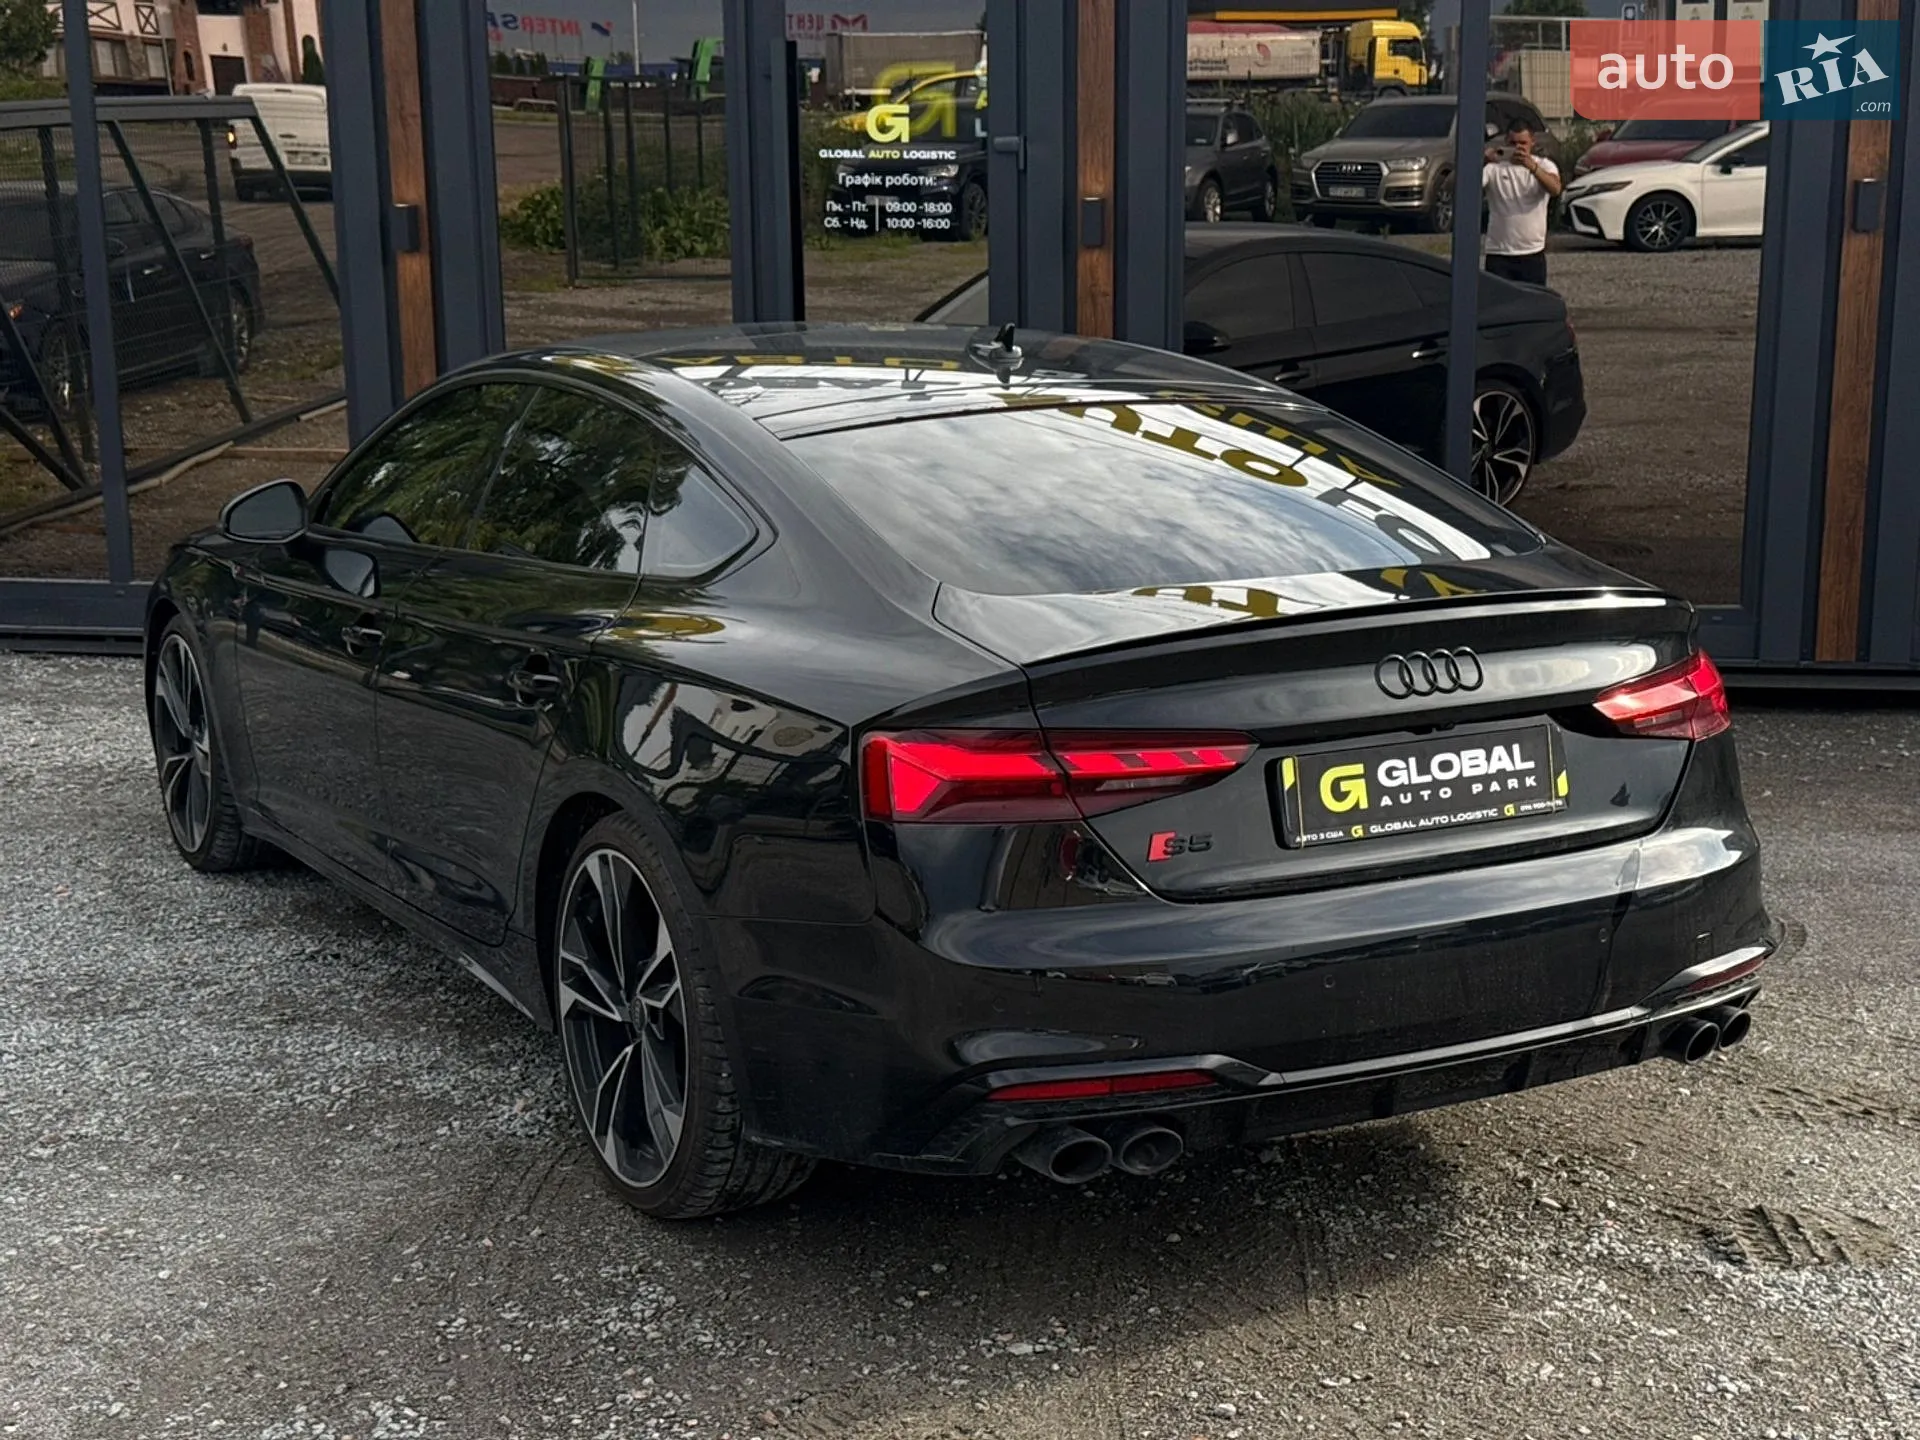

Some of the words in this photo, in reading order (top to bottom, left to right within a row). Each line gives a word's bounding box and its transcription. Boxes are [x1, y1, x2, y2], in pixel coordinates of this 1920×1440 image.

[819, 149, 865, 159] GLOBAL
[868, 150, 900, 159] AUTO
[903, 151, 957, 160] LOGISTIC
[838, 173, 882, 188] Графік
[885, 173, 937, 188] роботи:
[885, 202, 917, 213] 09:00
[886, 218, 915, 229] 10:00
[1377, 743, 1536, 788] GLOBAL
[1380, 786, 1453, 807] AUTO
[1472, 775, 1538, 795] PARK
[1370, 819, 1416, 834] GLOBAL
[1418, 815, 1449, 827] AUTO
[1450, 808, 1498, 823] LOGISTIC
[1160, 831, 1213, 857] S5
